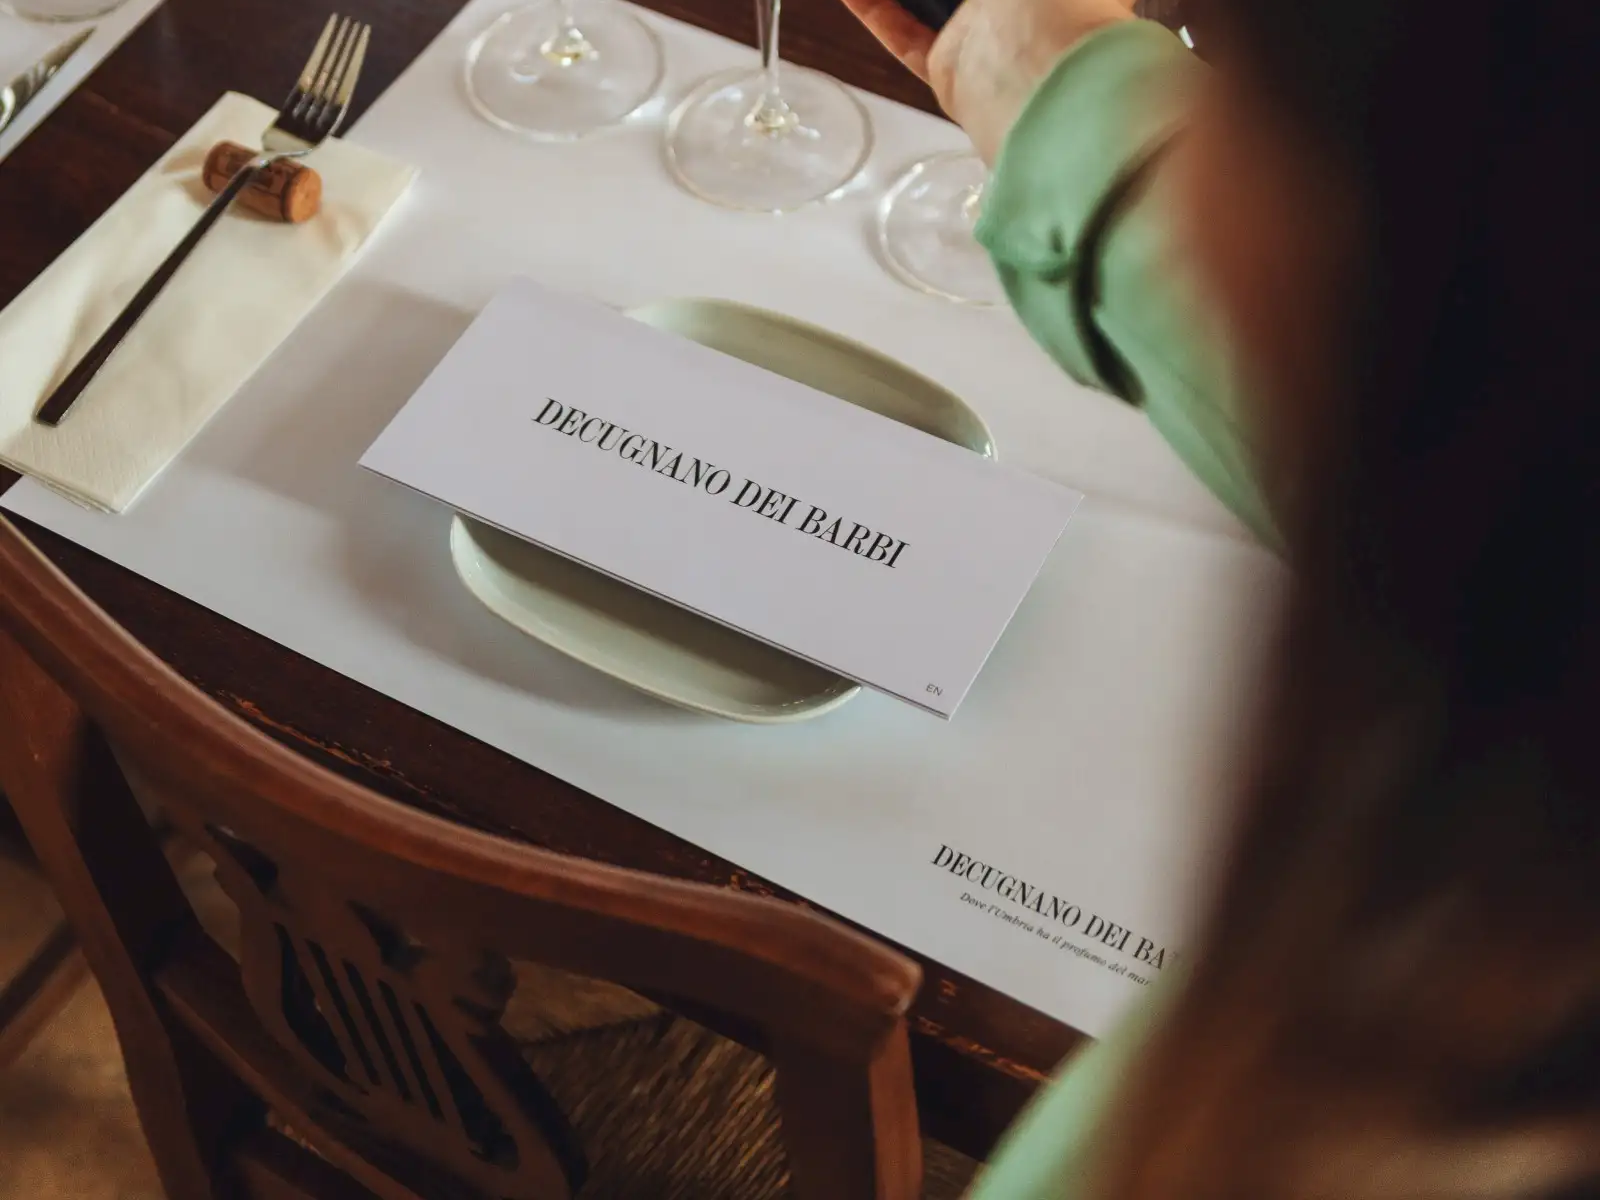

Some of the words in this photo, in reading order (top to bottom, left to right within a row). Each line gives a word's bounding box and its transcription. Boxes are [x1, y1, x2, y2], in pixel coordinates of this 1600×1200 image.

[531, 397, 732, 496] DECUGNANO
[729, 478, 802, 525] DEI
[796, 504, 911, 569] BARBI
[925, 682, 944, 698] EN
[930, 843, 1082, 928] DECUGNANO
[1081, 913, 1132, 952] DEI
[1132, 936, 1167, 970] BA
[959, 891, 987, 910] Dove
[1036, 926, 1051, 941] ha
[1059, 938, 1107, 967] profumo
[1107, 962, 1128, 976] del
[1127, 971, 1152, 987] mar
